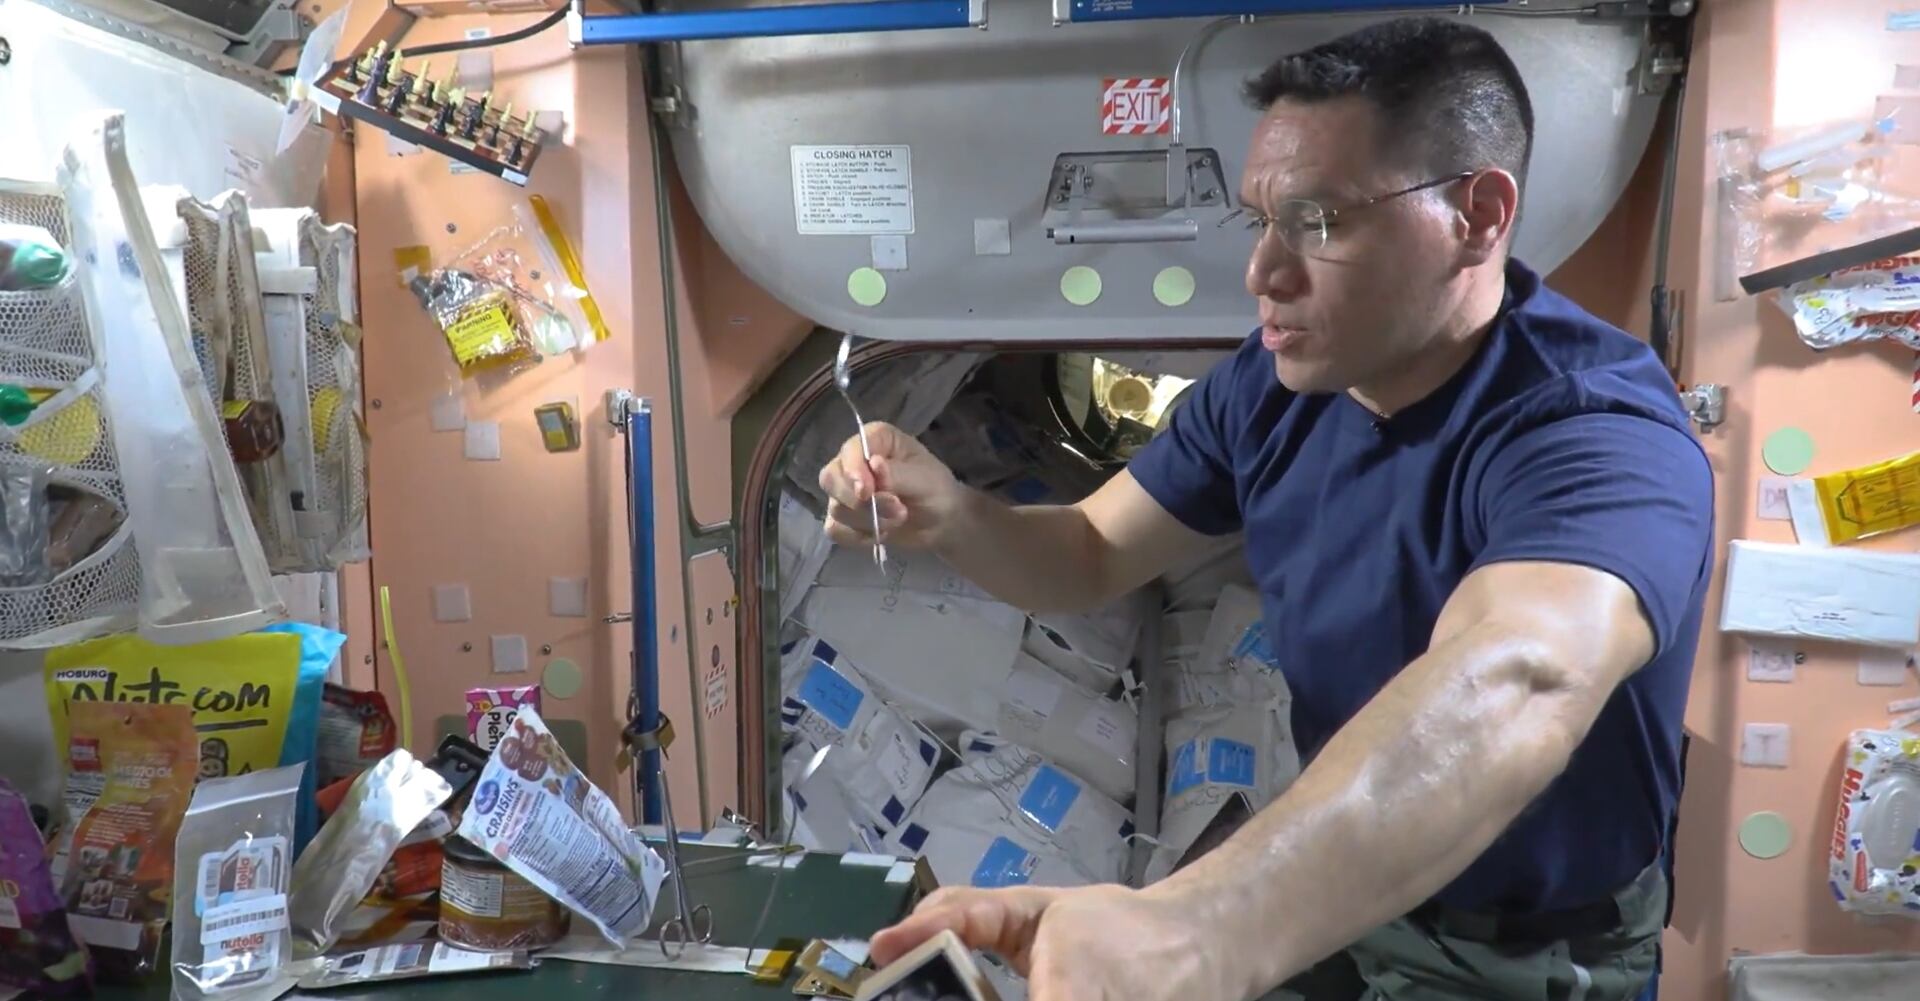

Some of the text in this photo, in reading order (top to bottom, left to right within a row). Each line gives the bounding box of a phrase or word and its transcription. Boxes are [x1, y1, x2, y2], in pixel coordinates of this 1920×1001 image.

[1113, 92, 1160, 120] EXIT
[813, 149, 893, 160] CLOSING HATCH
[56, 669, 108, 680] HOBURG
[486, 776, 521, 838] CRAISINS
[1834, 767, 1863, 861] HUGGIES
[220, 932, 265, 950] nutella
